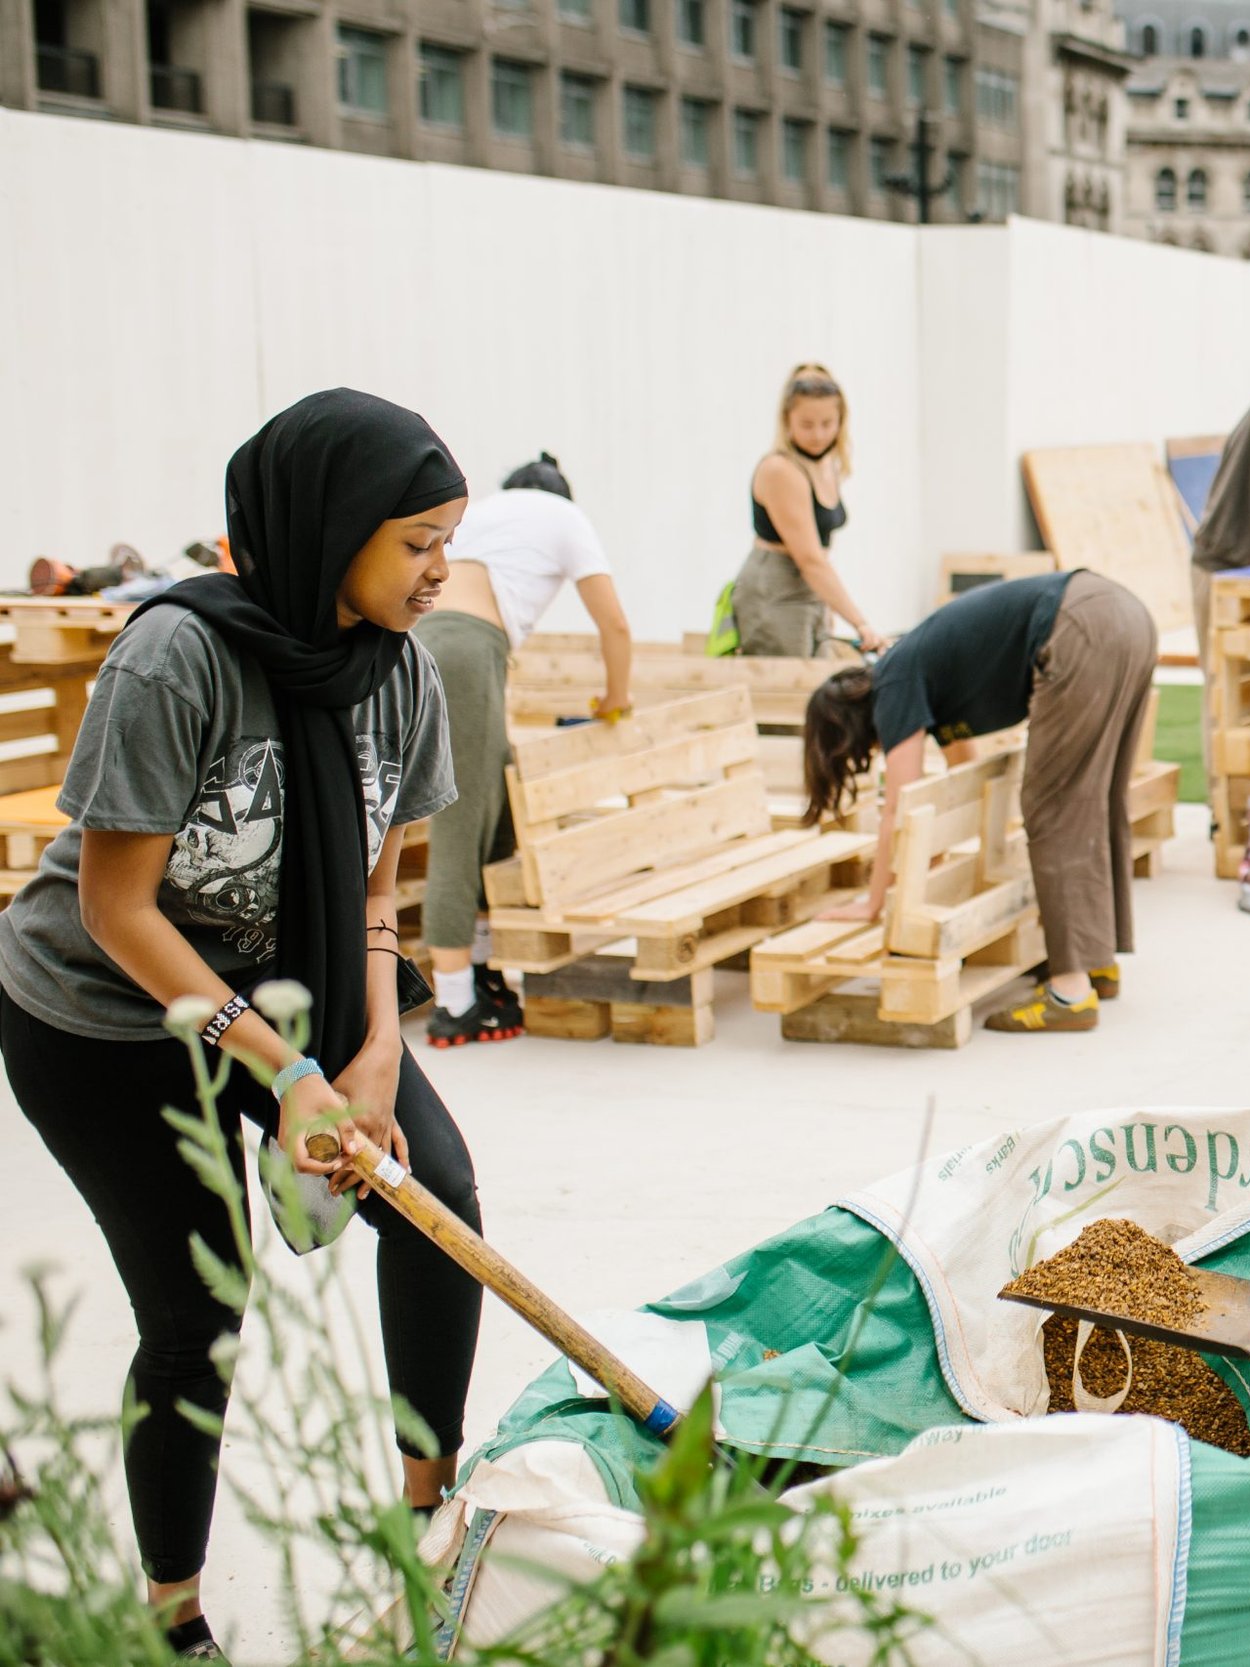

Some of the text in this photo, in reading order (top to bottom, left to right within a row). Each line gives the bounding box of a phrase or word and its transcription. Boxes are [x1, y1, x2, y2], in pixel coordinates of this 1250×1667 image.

[912, 1486, 1008, 1514] available
[941, 1560, 962, 1581] to
[969, 1543, 1019, 1578] your
[1025, 1528, 1073, 1554] door
